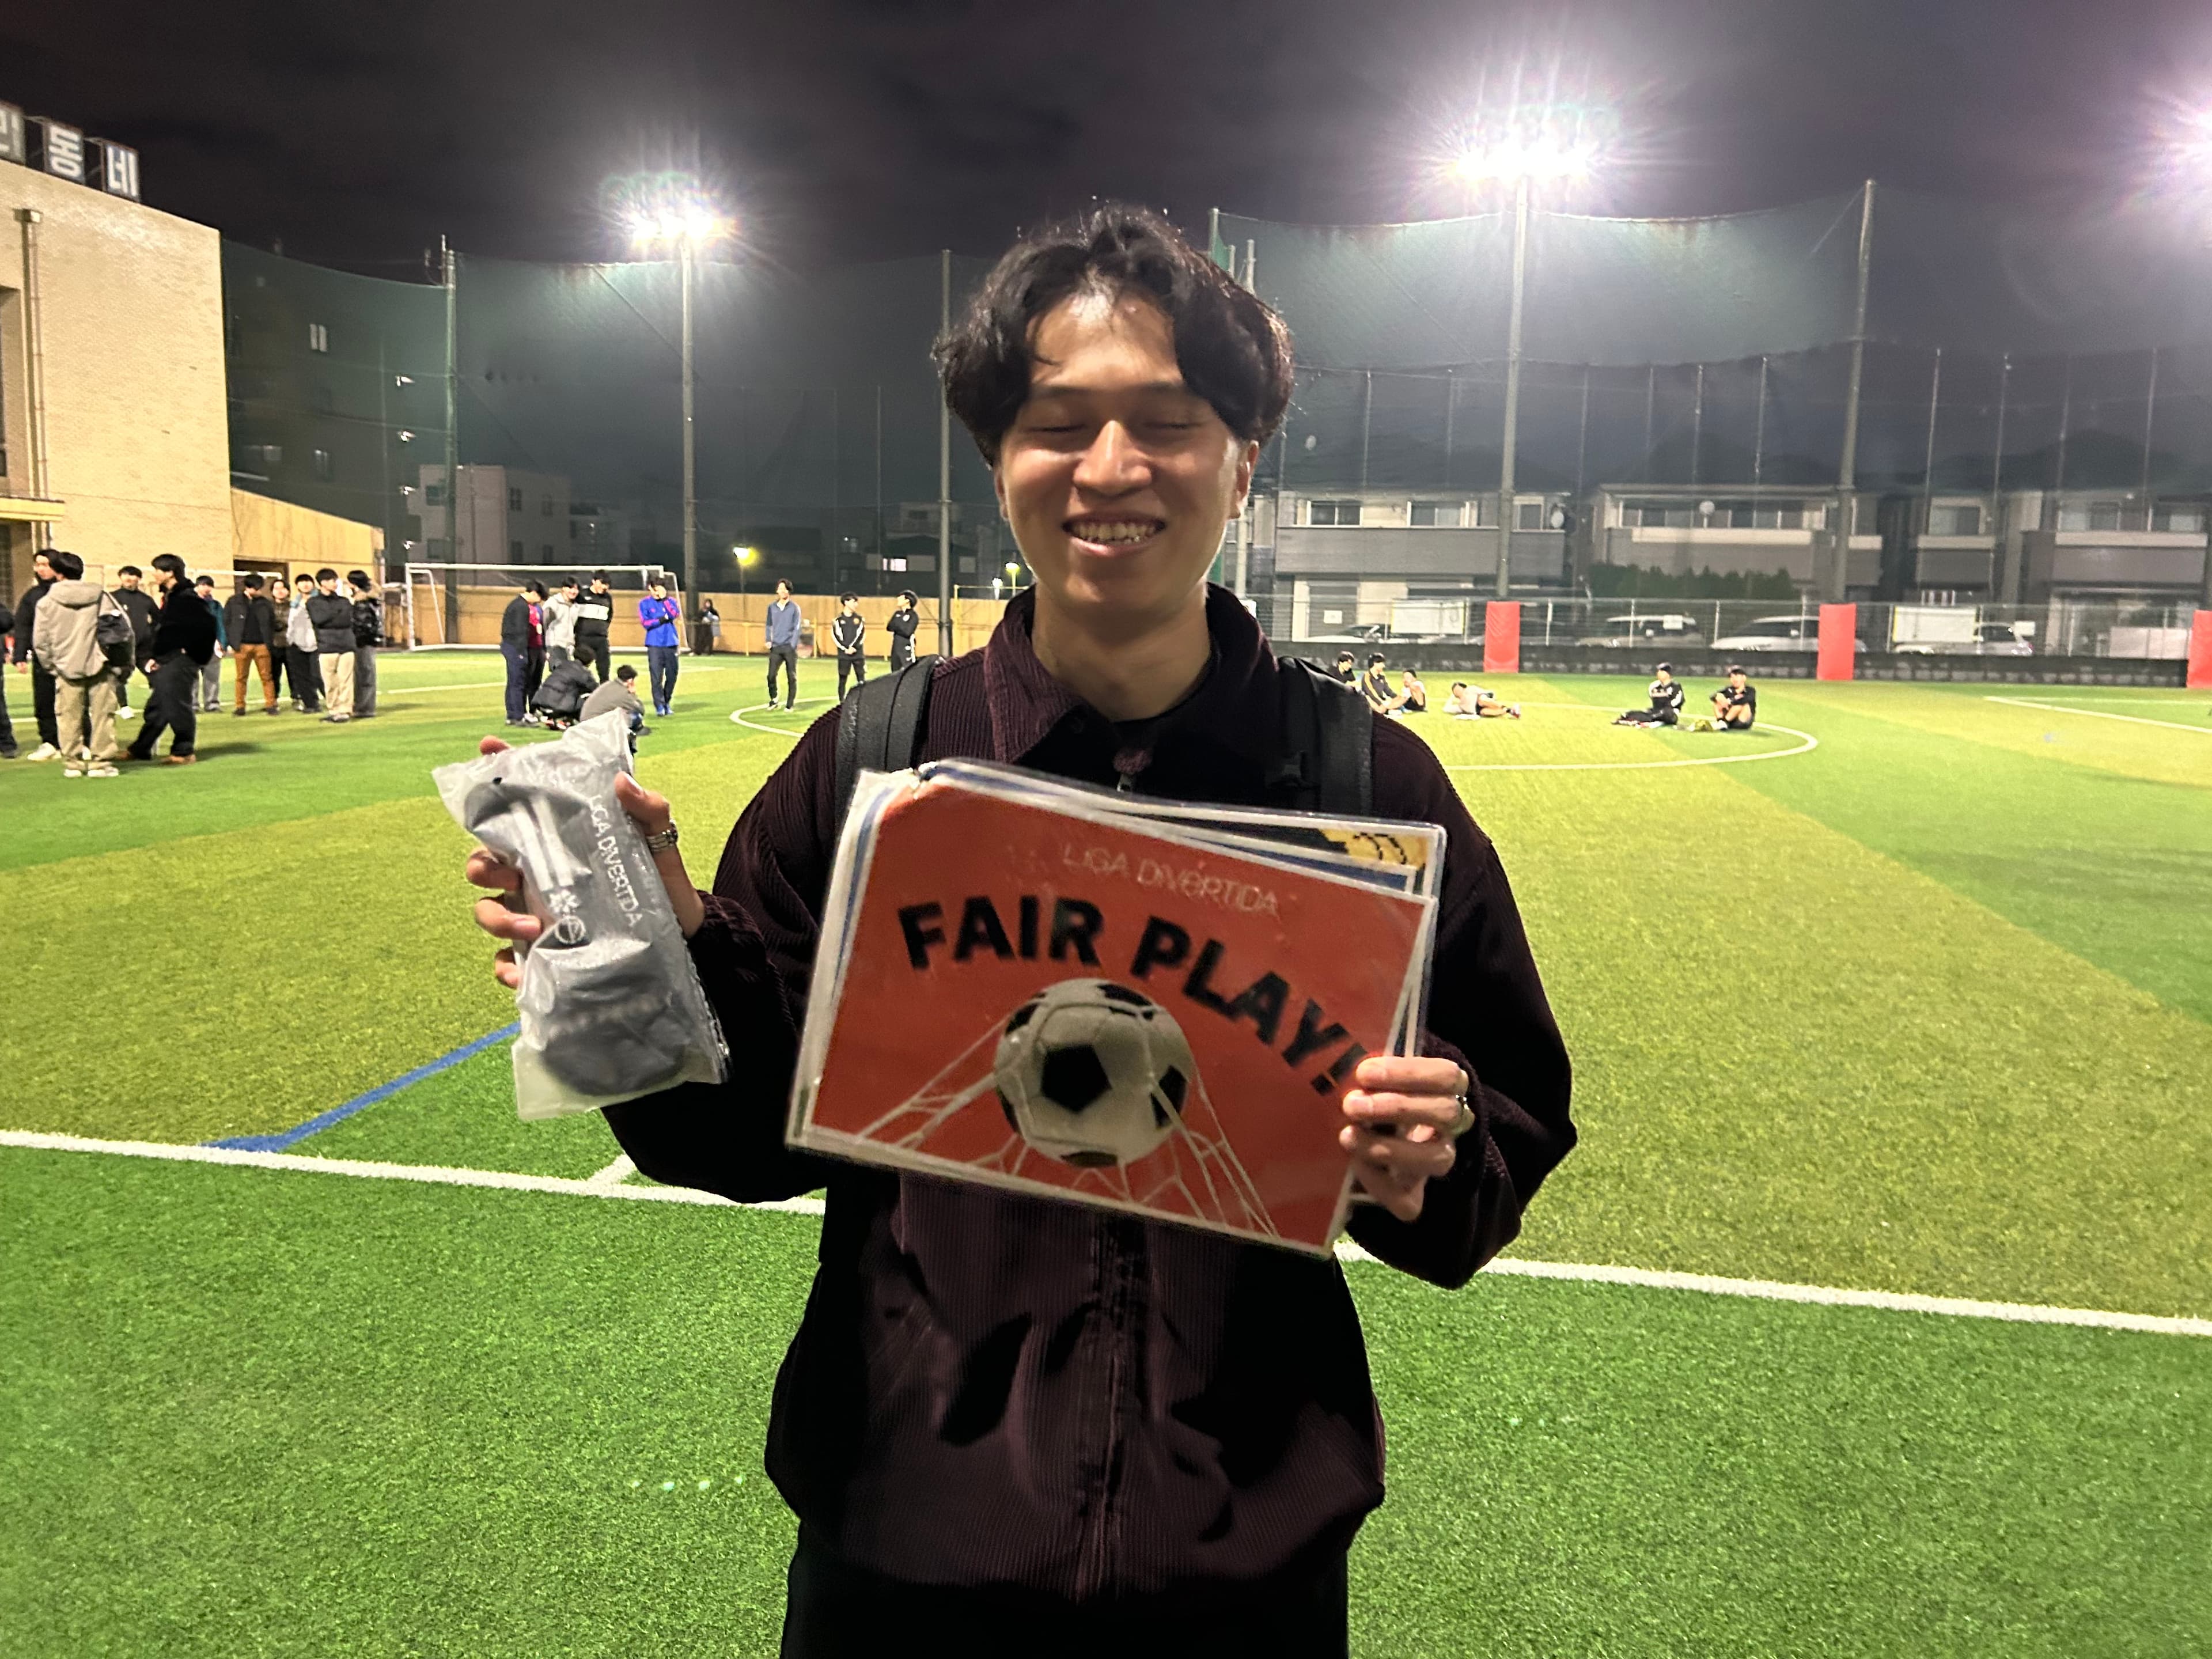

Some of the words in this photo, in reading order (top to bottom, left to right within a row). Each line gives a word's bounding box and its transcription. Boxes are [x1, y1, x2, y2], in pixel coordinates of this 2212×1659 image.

[1062, 843, 1130, 879] LIGA
[1137, 858, 1280, 916] DIVERTIDA
[898, 895, 1104, 969] FAIR
[1130, 916, 1369, 1096] PLAY!
